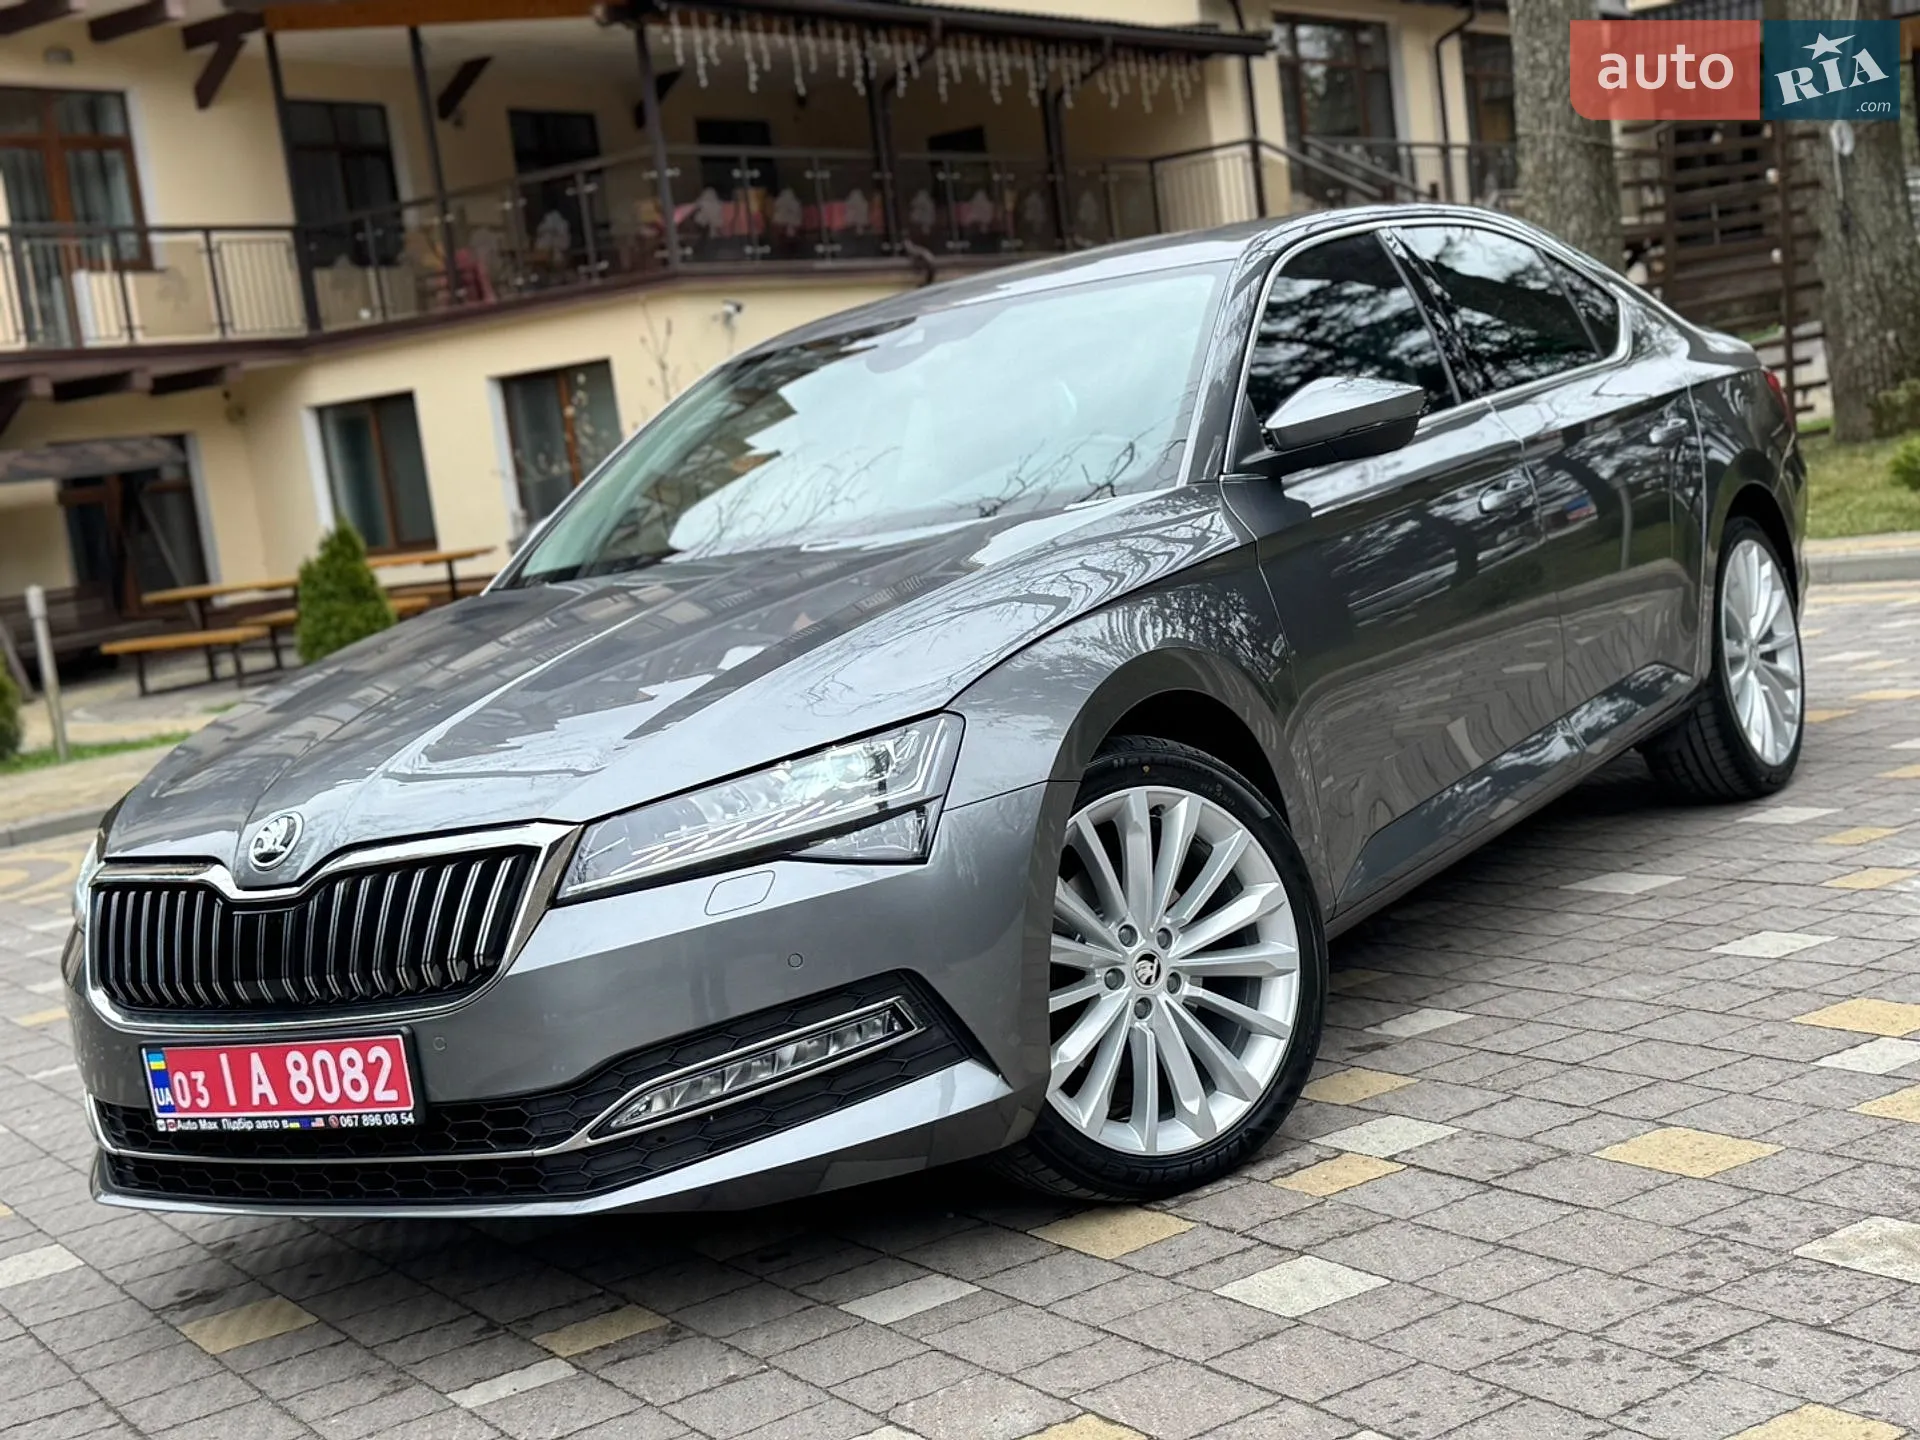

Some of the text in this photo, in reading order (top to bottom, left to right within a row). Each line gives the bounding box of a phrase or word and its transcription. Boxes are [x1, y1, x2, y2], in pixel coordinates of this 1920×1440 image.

[173, 1071, 210, 1109] 03
[285, 1045, 399, 1105] 8082
[155, 1087, 174, 1106] UA
[177, 1119, 197, 1130] Auto
[198, 1119, 218, 1130] Max
[255, 1119, 280, 1129] авто
[340, 1115, 359, 1127] 067
[362, 1114, 382, 1126] 896
[383, 1113, 398, 1125] 08
[400, 1112, 415, 1124] 54
